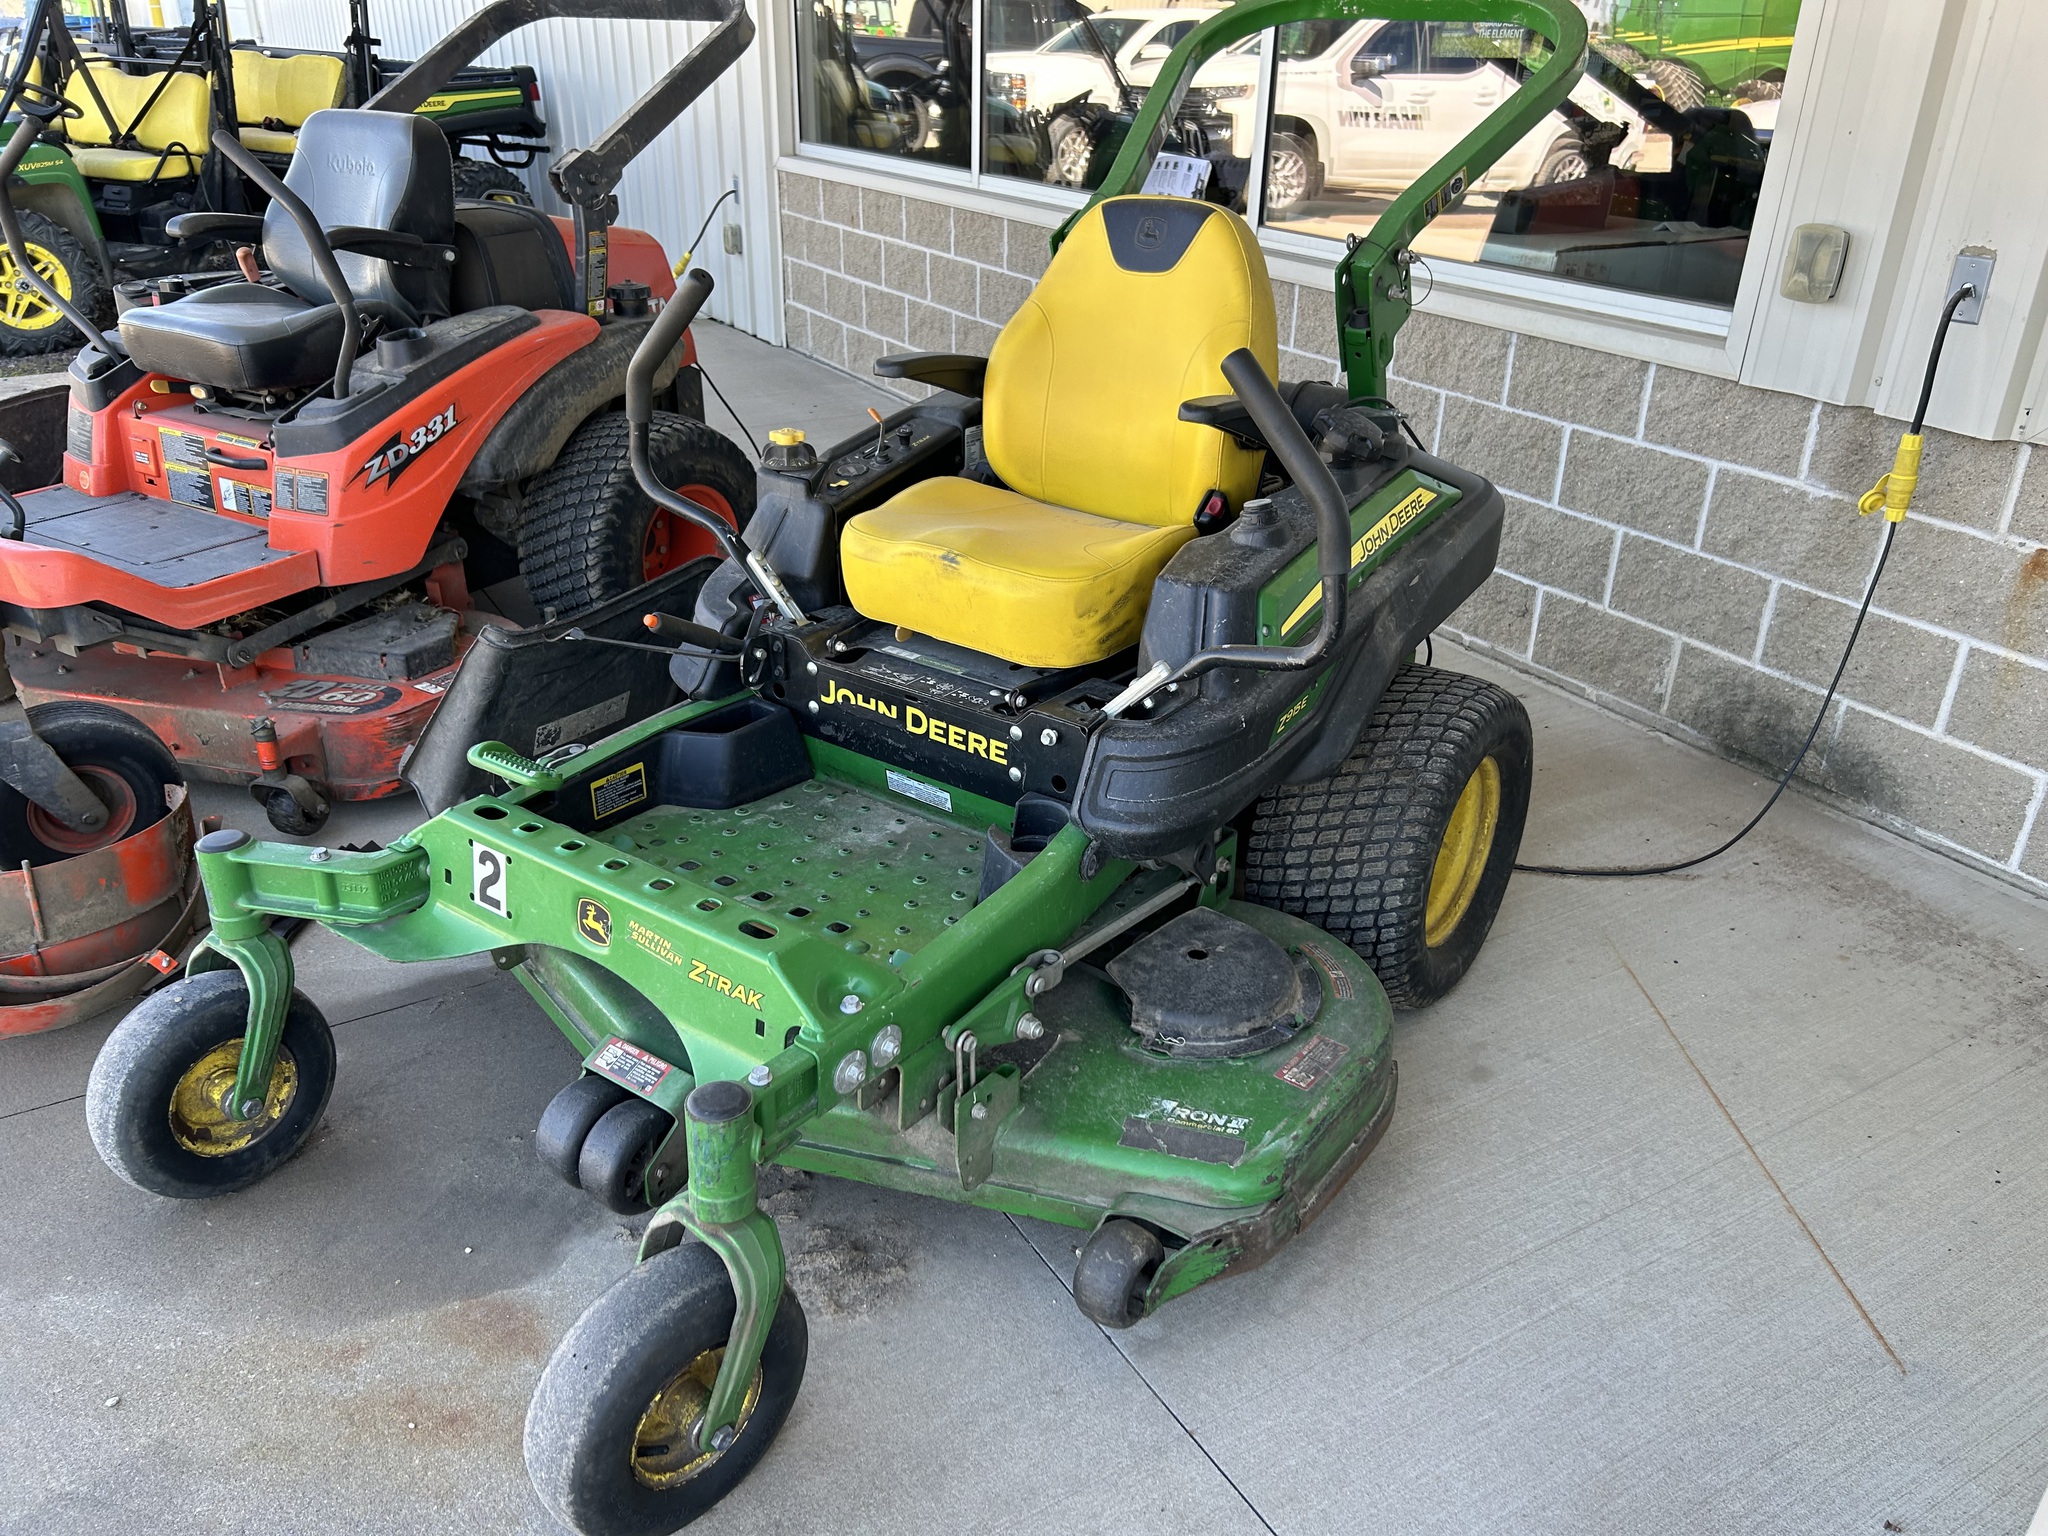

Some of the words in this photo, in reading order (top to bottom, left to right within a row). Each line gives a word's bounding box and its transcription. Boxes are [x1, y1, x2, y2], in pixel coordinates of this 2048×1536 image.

[1478, 28, 1491, 38] THE
[423, 100, 446, 108] DEERE
[364, 403, 458, 486] ZD331
[1360, 523, 1392, 562] JOHN
[1388, 493, 1427, 535] DEERE
[318, 690, 379, 704] 60
[905, 705, 1009, 766] DEERE
[479, 850, 502, 912] 2
[628, 920, 672, 950] MARTIN
[631, 932, 683, 966] SULLIVAN
[688, 957, 765, 1012] ZTRAK
[621, 1043, 640, 1057] DANGER
